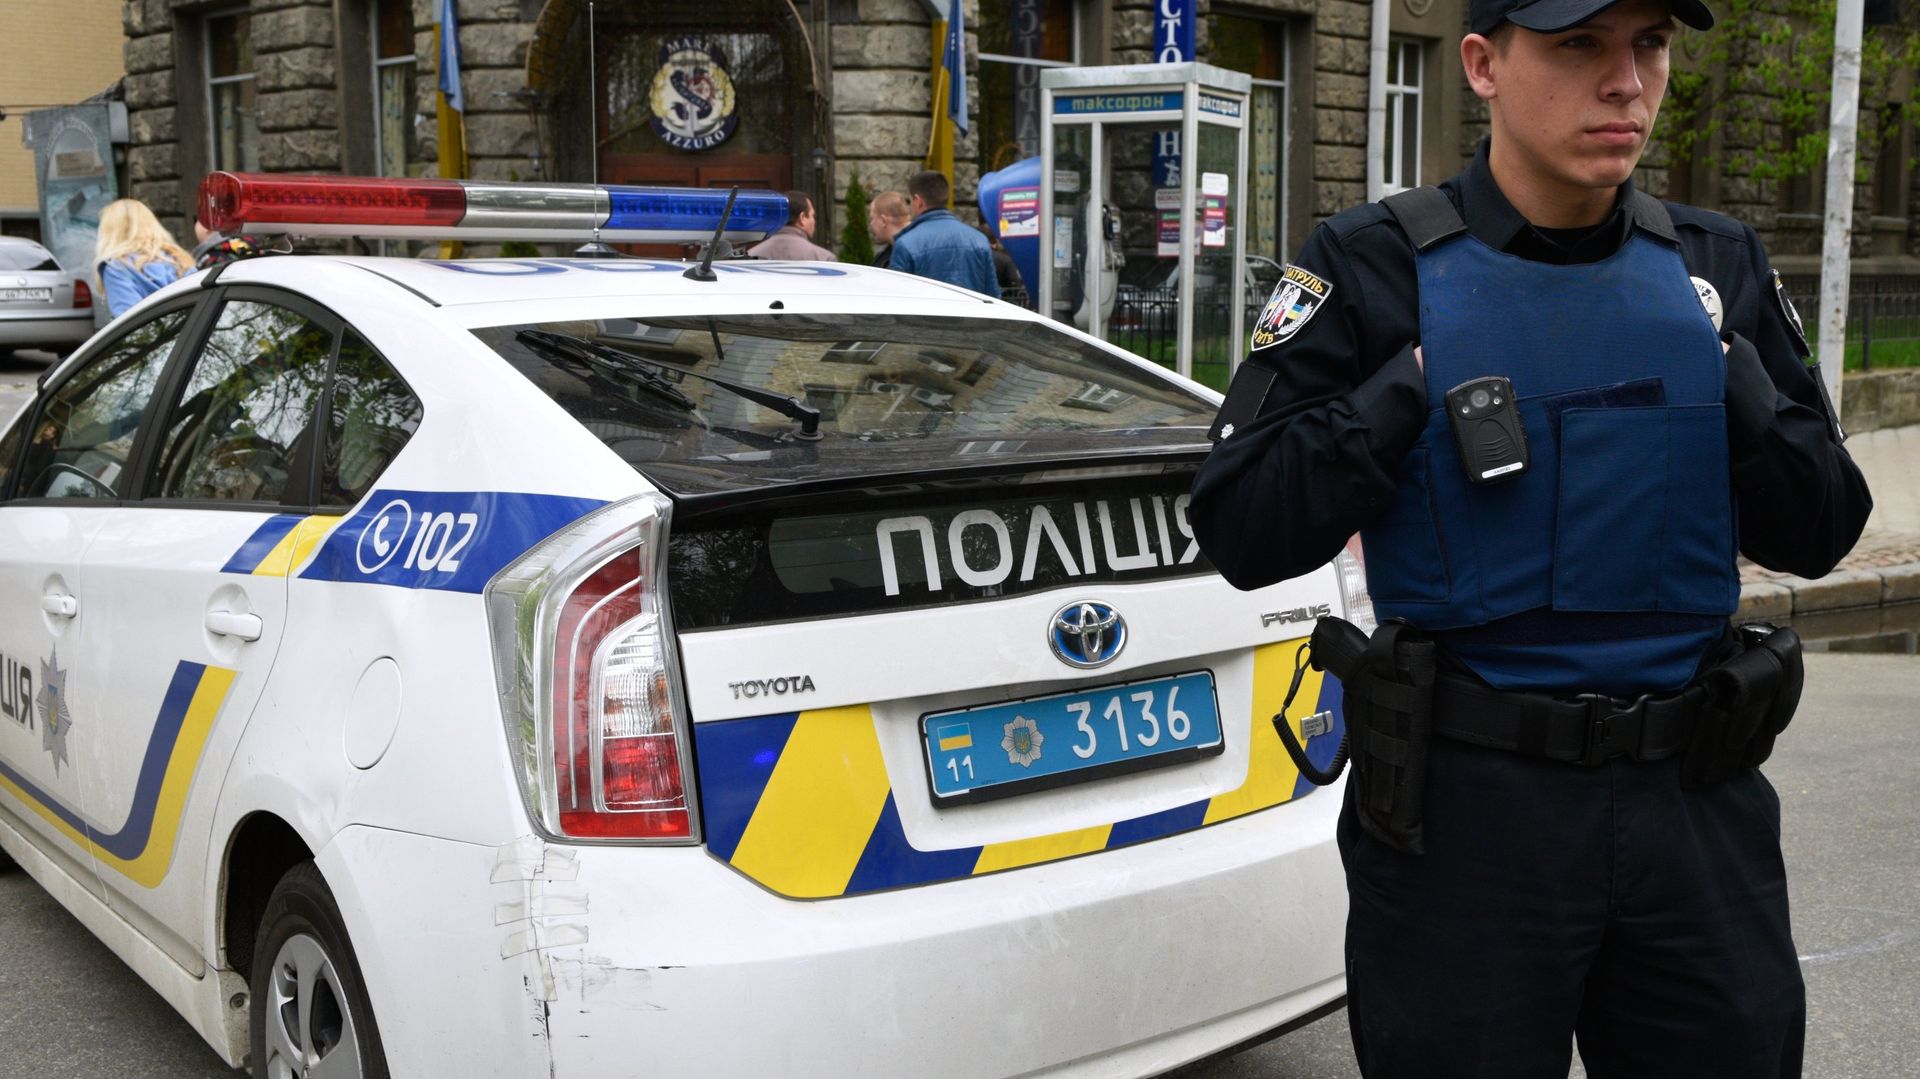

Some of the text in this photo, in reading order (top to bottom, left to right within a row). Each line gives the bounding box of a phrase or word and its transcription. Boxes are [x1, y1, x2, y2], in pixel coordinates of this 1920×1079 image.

[661, 130, 726, 150] AZZURO
[403, 511, 478, 572] 102
[1261, 603, 1331, 628] PRIUS
[728, 675, 816, 700] TOYOTA
[1066, 686, 1191, 759] 3136
[946, 755, 974, 783] 11
